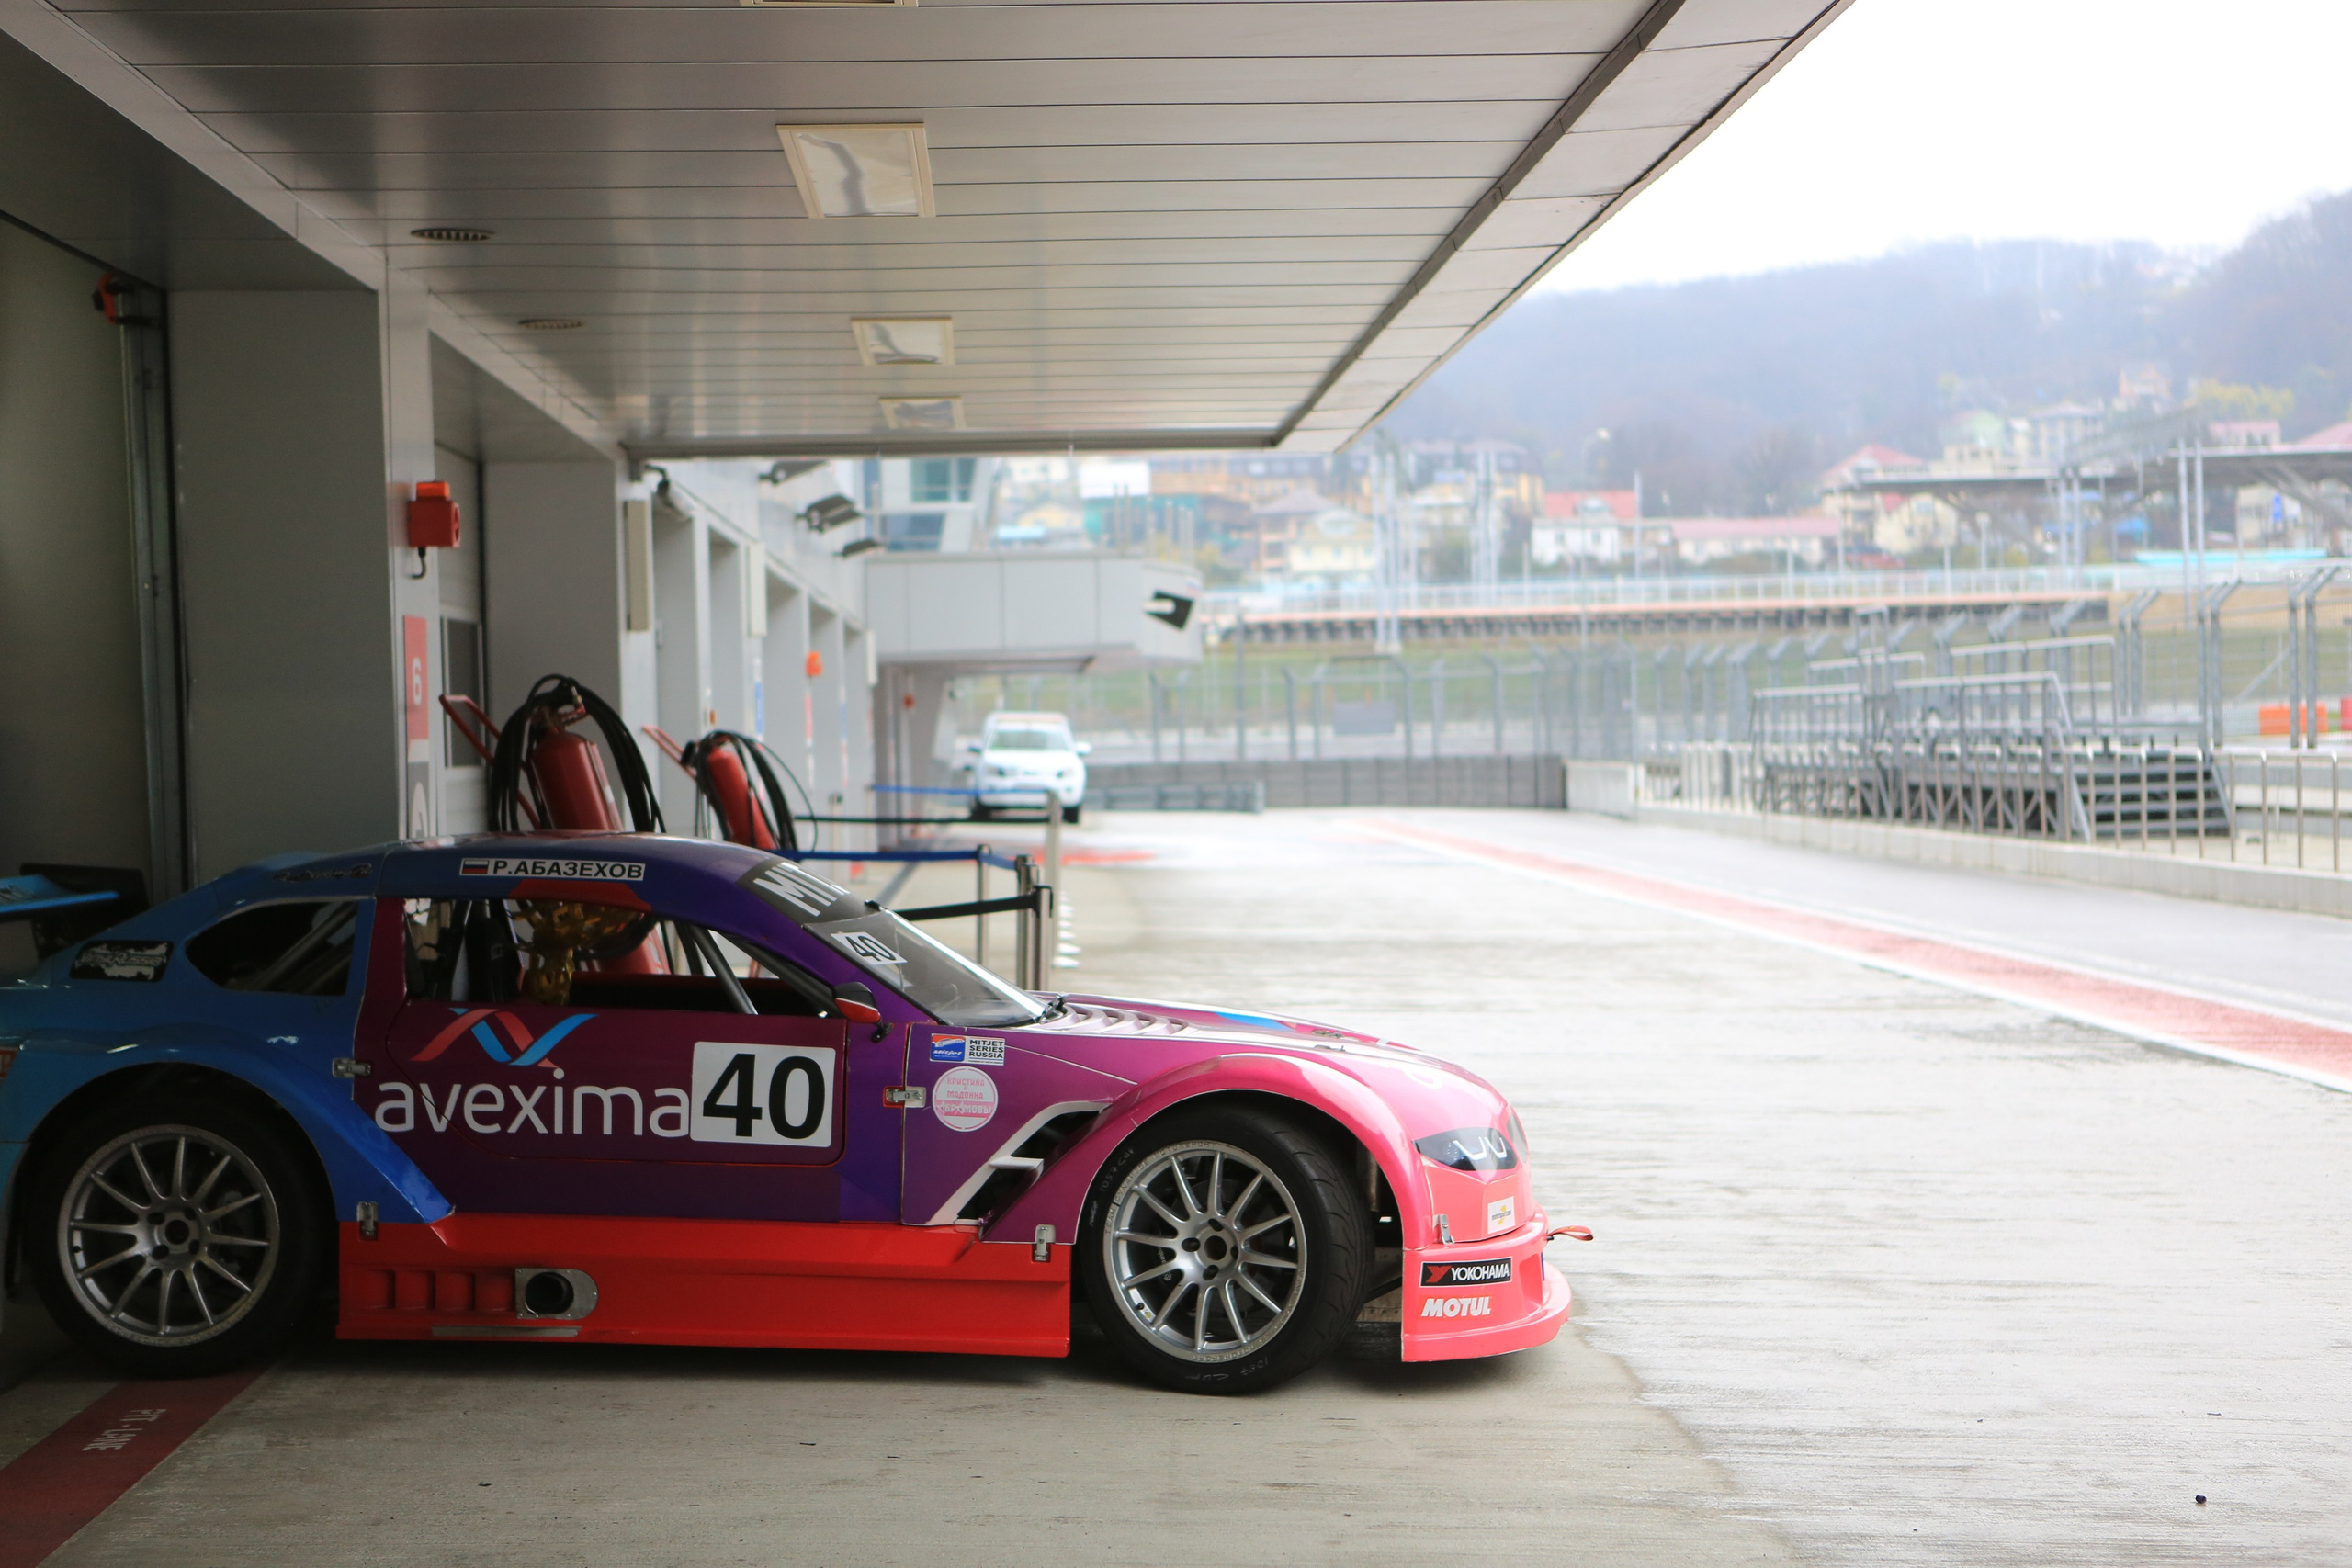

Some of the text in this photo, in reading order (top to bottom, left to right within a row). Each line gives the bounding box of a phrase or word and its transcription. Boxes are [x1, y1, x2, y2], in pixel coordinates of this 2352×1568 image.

[413, 657, 423, 706] 6
[493, 860, 643, 879] Р.АБАЗЕХОВ
[845, 935, 897, 962] 40
[968, 1051, 1003, 1059] RUSSIA
[376, 1068, 689, 1138] avexima
[702, 1053, 826, 1140] 40
[1451, 1262, 1510, 1281] YOKOHAMA
[1420, 1296, 1492, 1317] MOTUL
